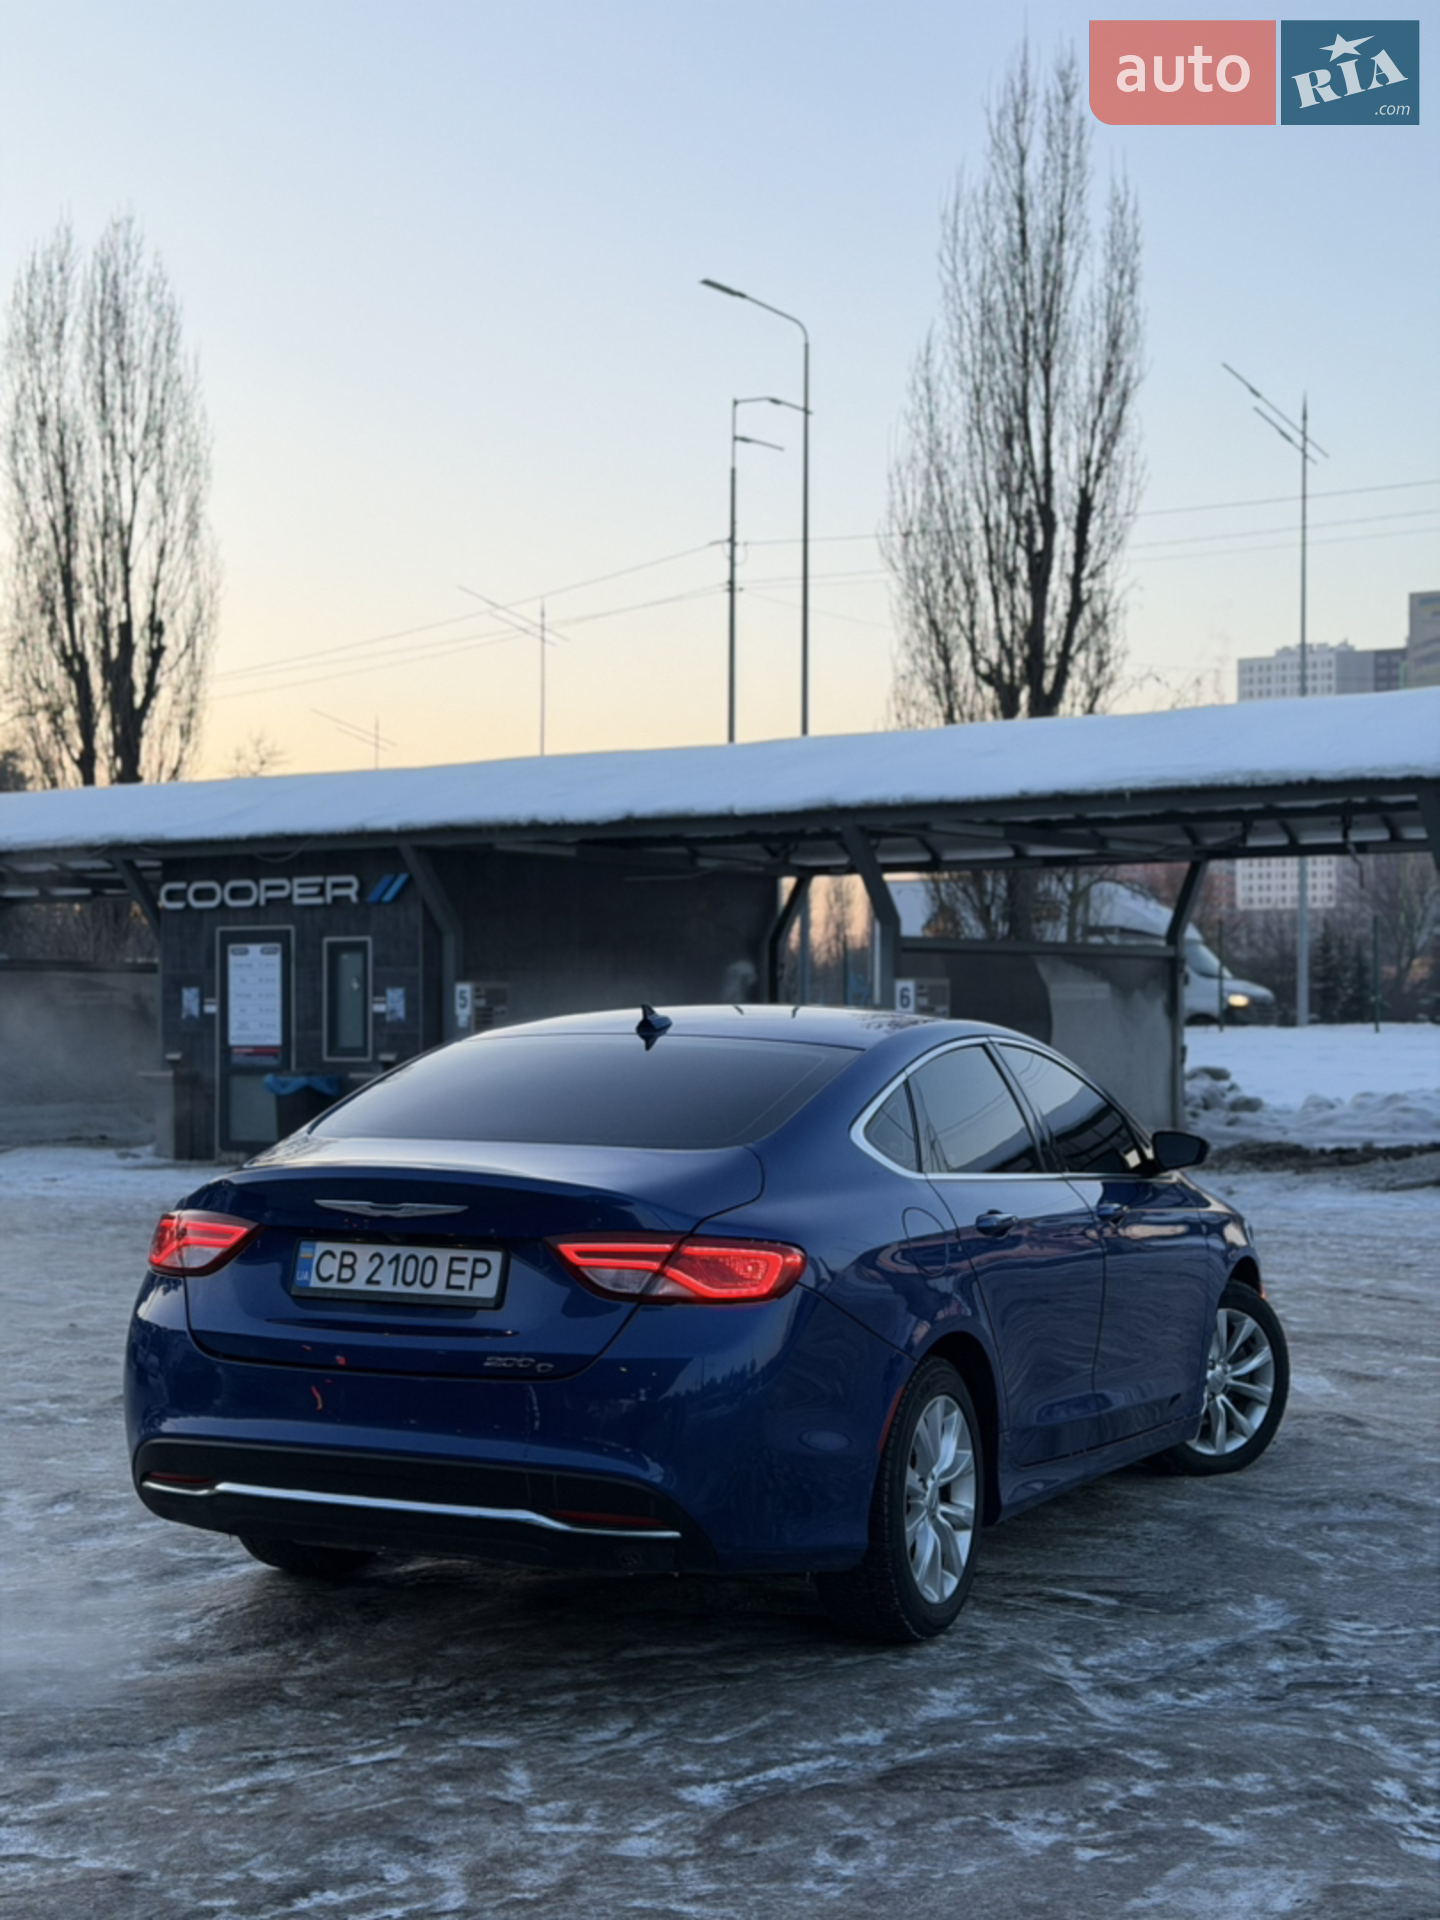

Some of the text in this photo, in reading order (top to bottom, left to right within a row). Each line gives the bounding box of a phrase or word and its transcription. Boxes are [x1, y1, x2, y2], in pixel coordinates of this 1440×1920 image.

[160, 875, 359, 909] COOPER
[458, 989, 468, 1009] 5
[899, 986, 911, 1009] 6
[296, 1270, 310, 1281] UA
[316, 1249, 493, 1291] CB 2100 EP
